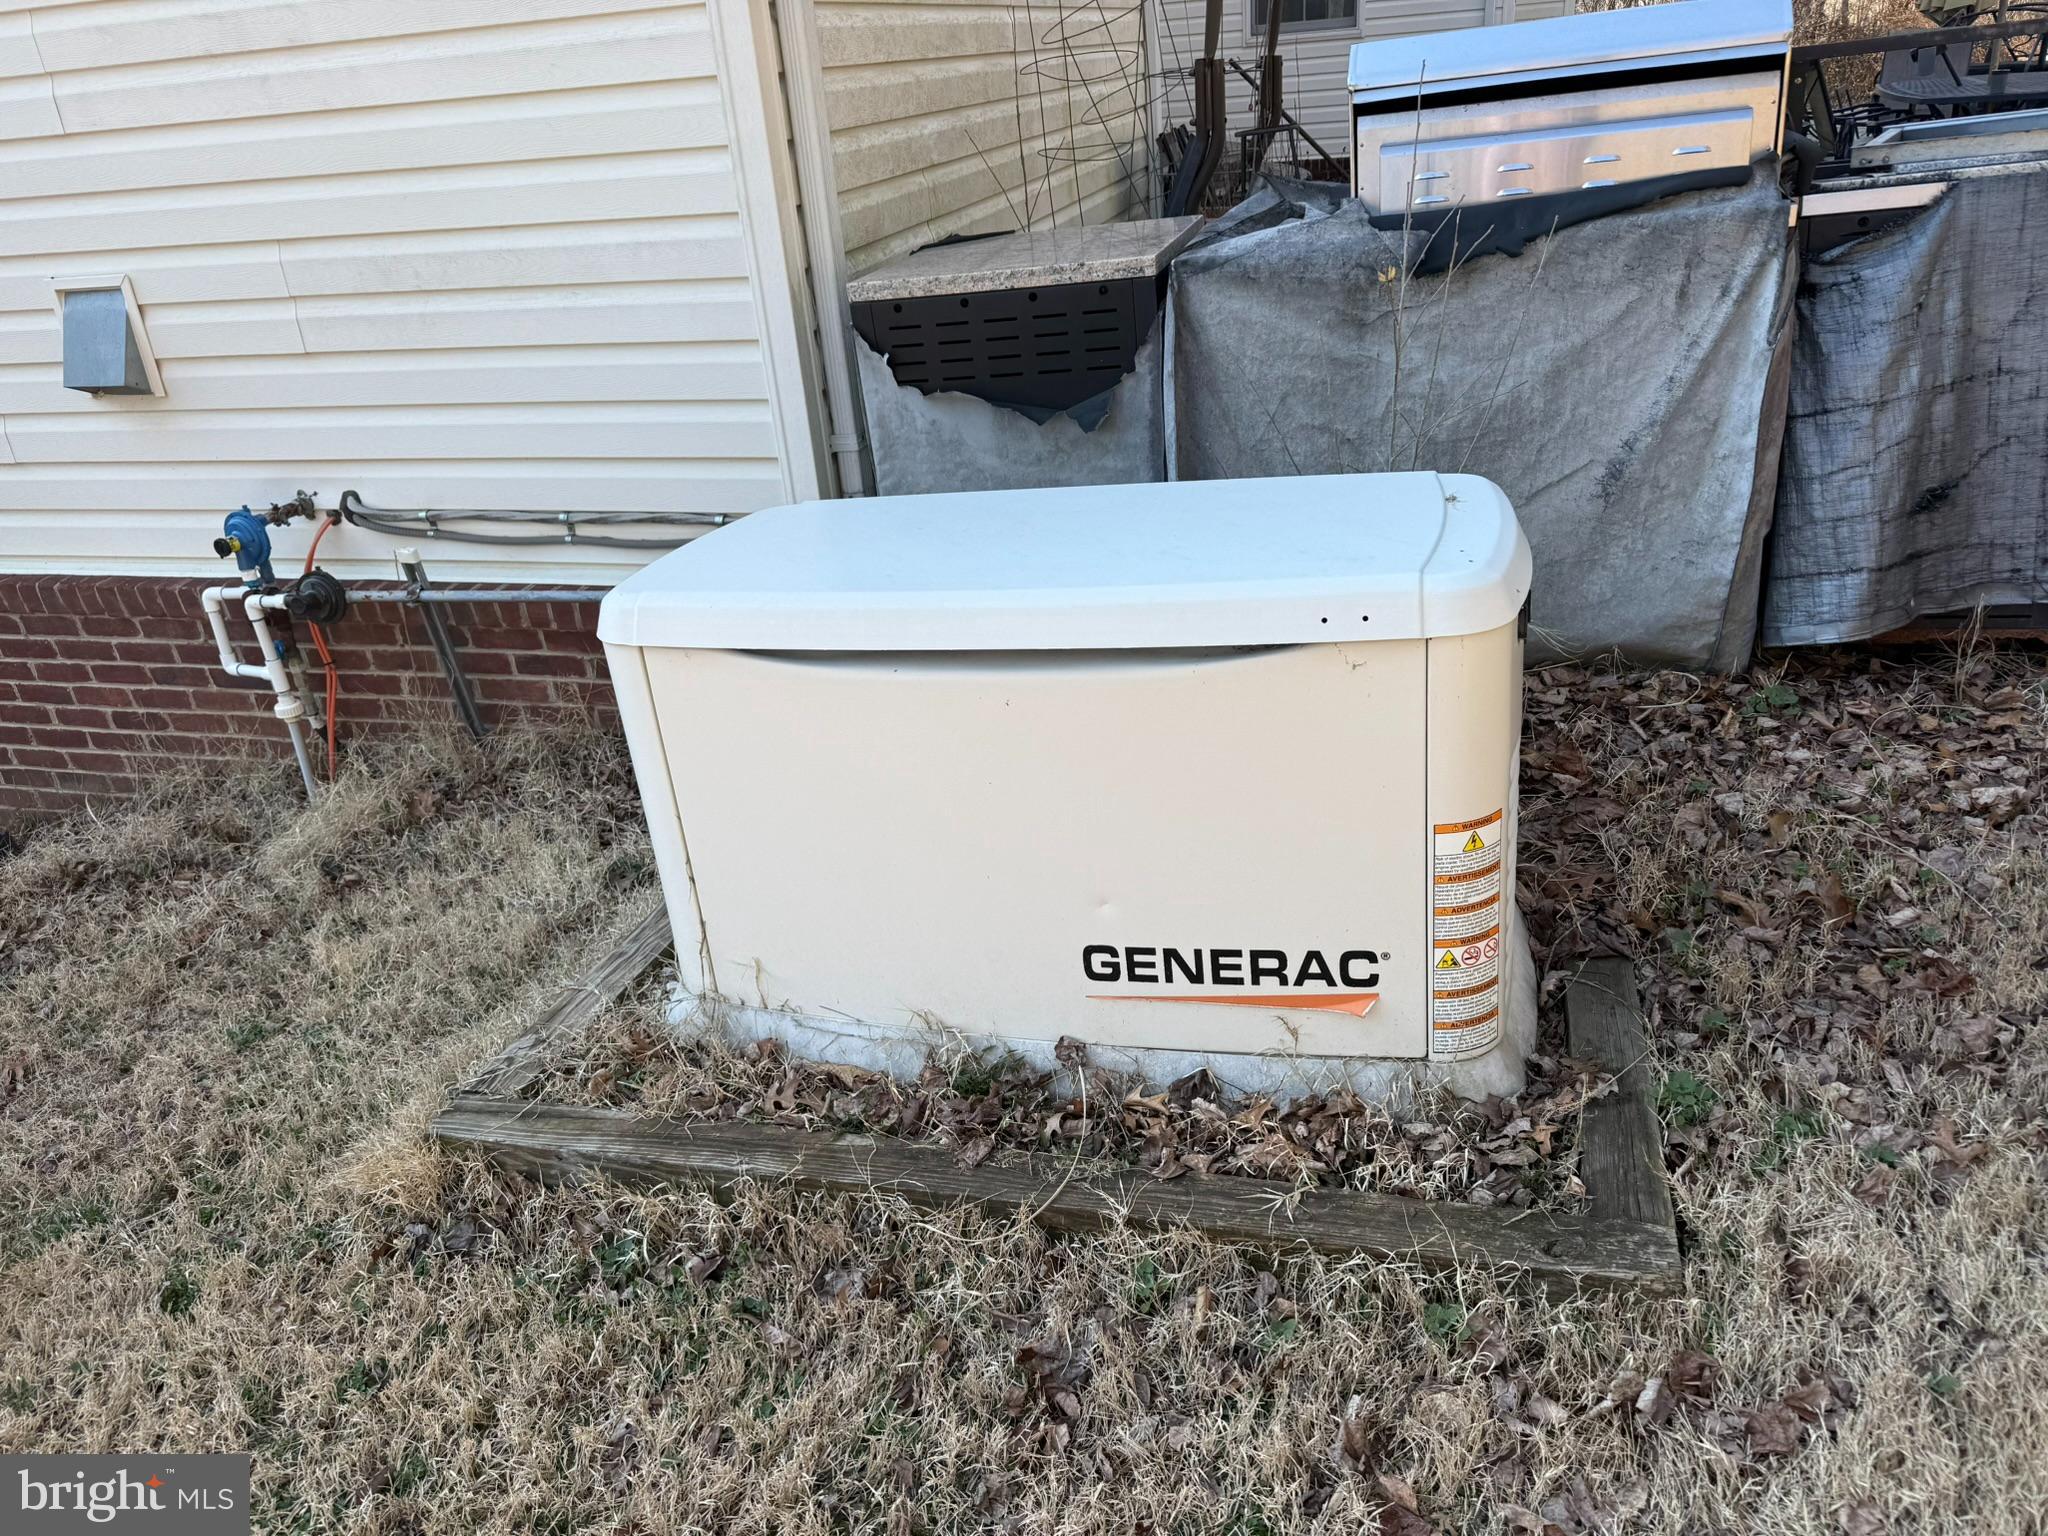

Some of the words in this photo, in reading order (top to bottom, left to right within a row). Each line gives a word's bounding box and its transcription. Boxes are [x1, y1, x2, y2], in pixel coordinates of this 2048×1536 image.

[1461, 815, 1493, 830] WARNING
[1450, 896, 1497, 914] ADVERTENCIA
[1459, 932, 1490, 945] WARNING
[1082, 944, 1380, 988] GENERAC
